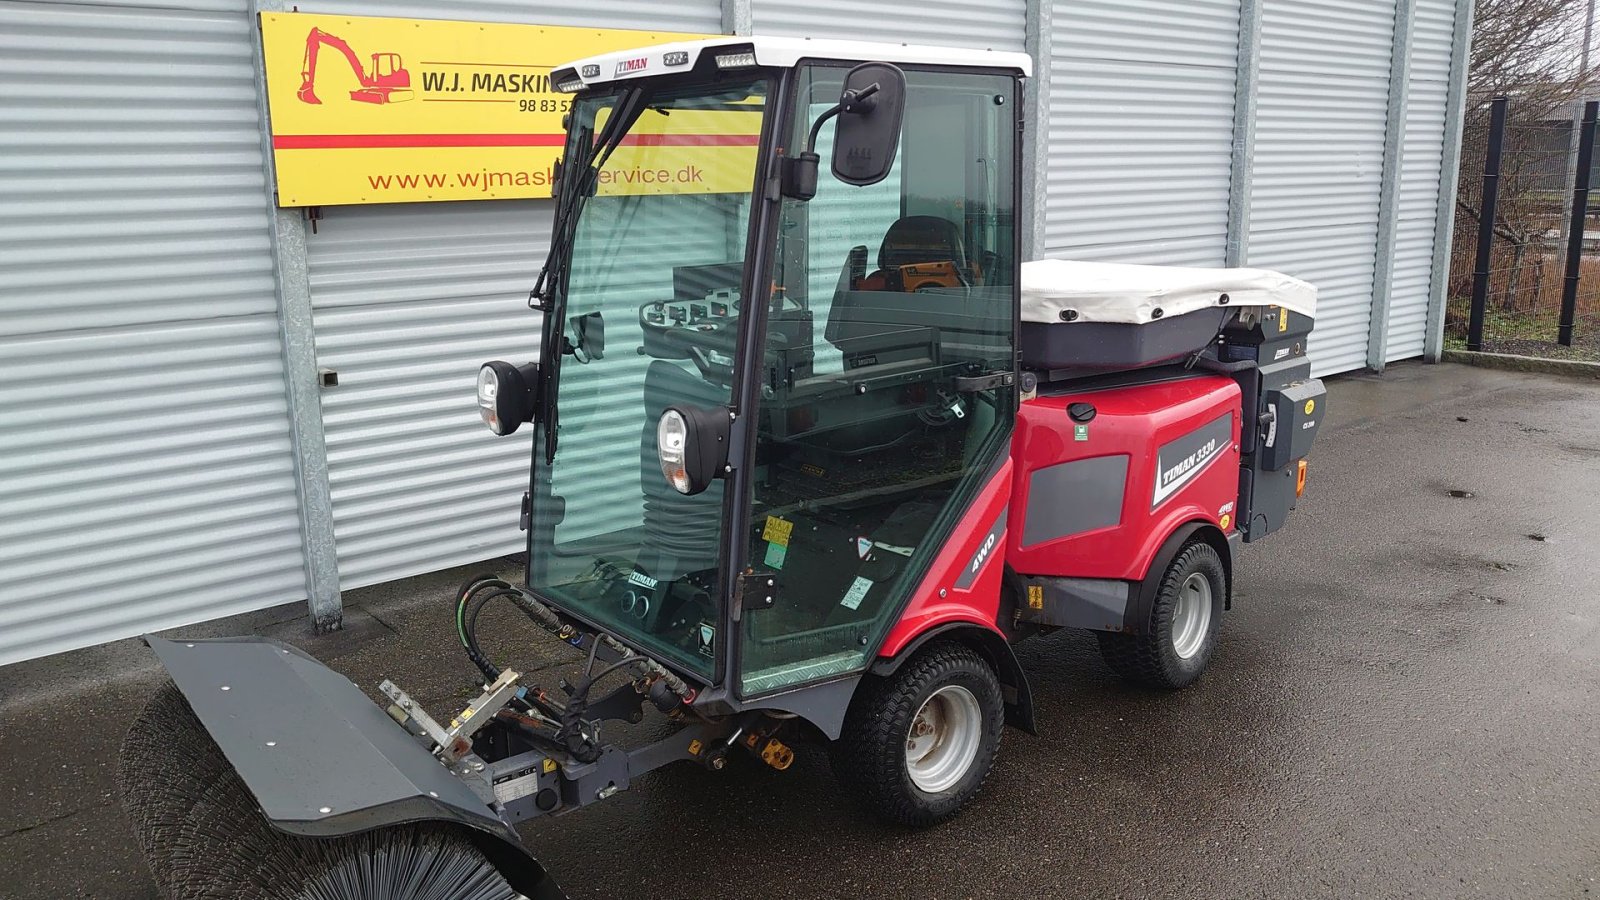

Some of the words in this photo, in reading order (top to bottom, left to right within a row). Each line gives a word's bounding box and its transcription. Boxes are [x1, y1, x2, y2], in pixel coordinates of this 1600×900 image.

[618, 58, 648, 72] TIMAN
[422, 72, 465, 92] W.J.
[519, 99, 536, 112] 98
[540, 100, 556, 112] 83
[1163, 452, 1197, 485] TIMAN
[1196, 438, 1216, 462] 3330
[971, 533, 995, 573] 4WD
[631, 571, 658, 588] TIMAN
